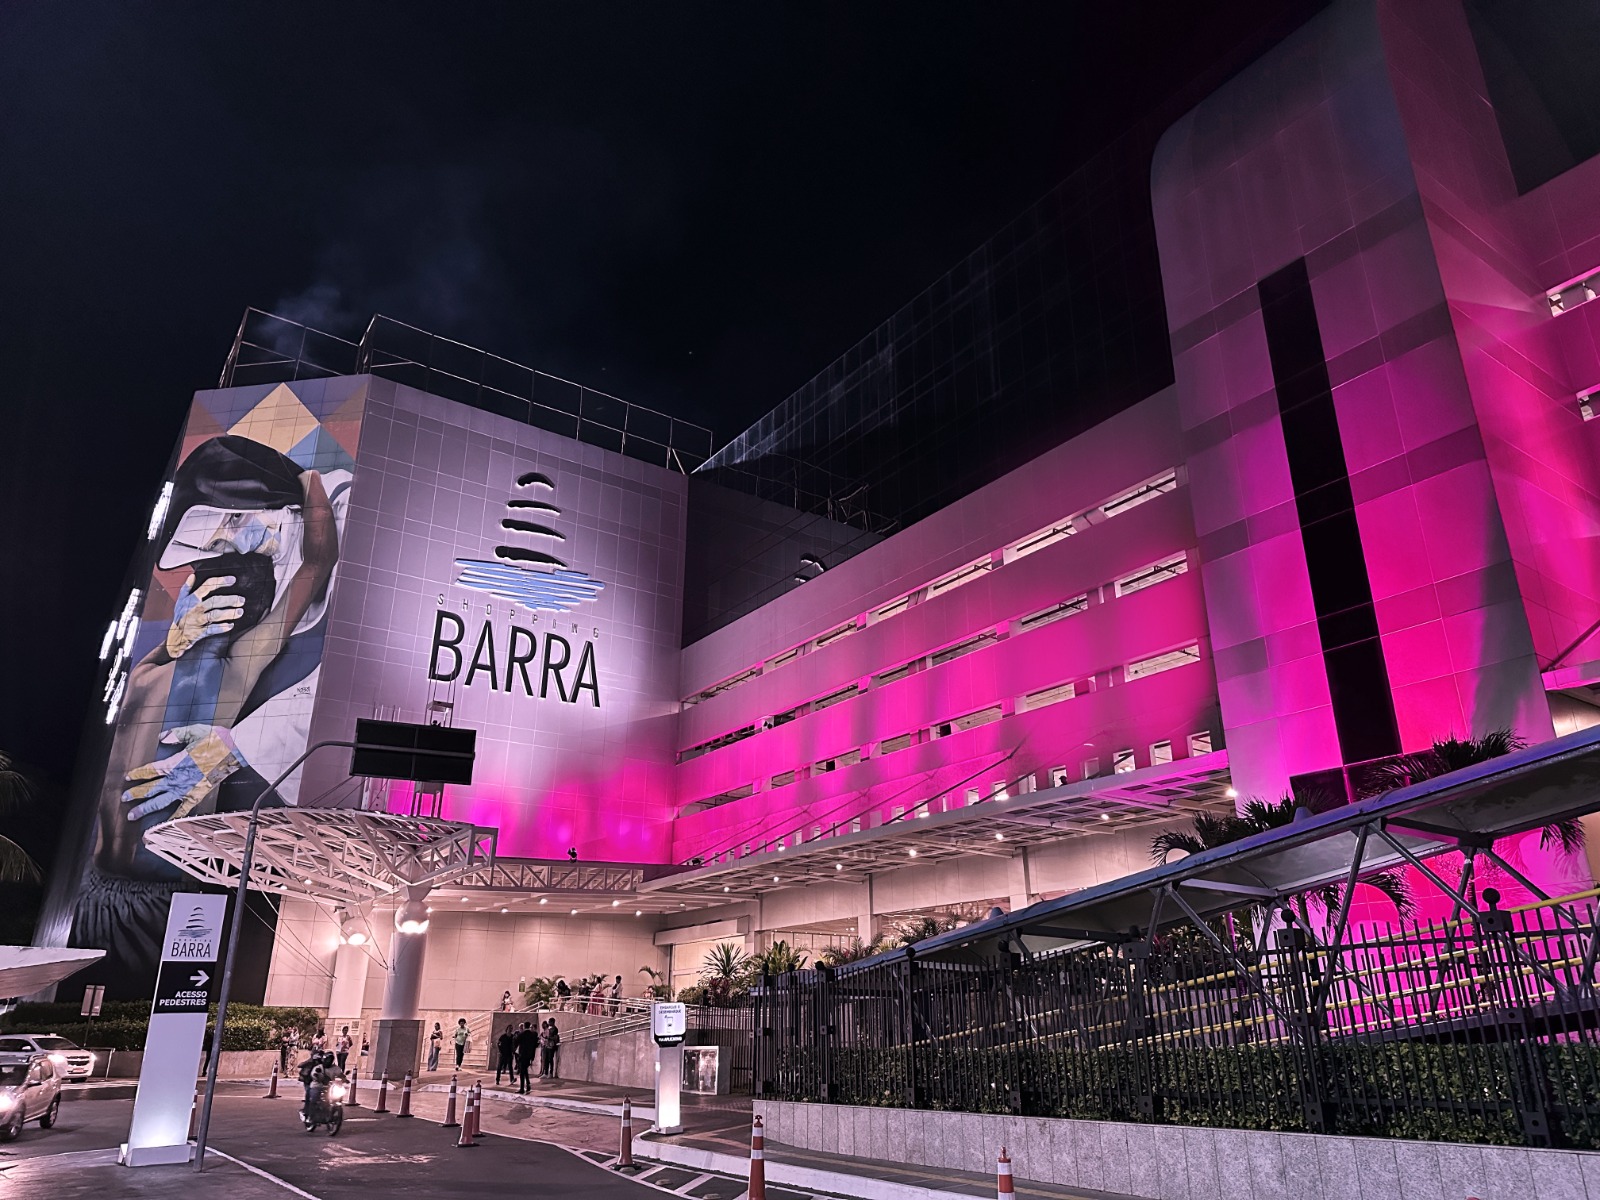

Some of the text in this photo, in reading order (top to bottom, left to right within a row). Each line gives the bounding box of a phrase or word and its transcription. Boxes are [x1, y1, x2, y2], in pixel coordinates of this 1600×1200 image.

[437, 593, 600, 638] SHOPPING
[428, 609, 600, 708] BARRA
[171, 942, 211, 958] BARRA
[159, 998, 207, 1006] PEDESTRES
[175, 990, 208, 998] ACESSO
